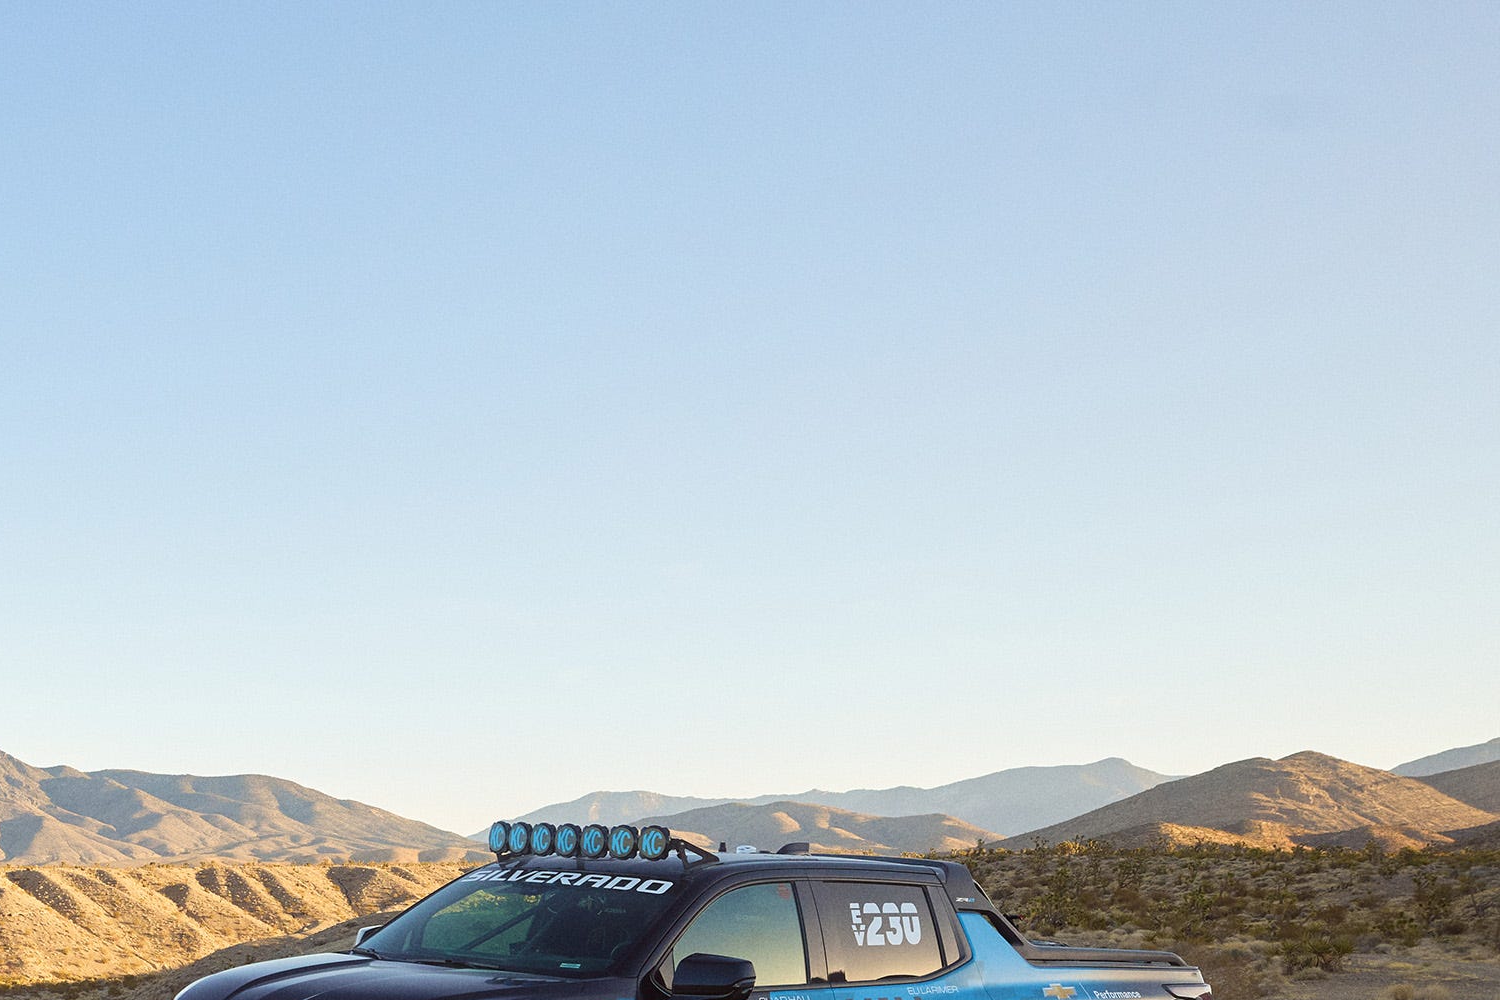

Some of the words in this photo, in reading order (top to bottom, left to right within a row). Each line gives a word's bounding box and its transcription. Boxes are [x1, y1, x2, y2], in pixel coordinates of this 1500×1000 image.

[490, 827, 504, 849] KC
[511, 826, 525, 850] KC
[533, 828, 548, 851] KC
[557, 828, 573, 852] KC
[583, 829, 601, 854] KC
[611, 830, 630, 855] KC
[642, 831, 662, 856] KC
[461, 869, 674, 895] SILVERADO
[863, 902, 921, 946] 230
[1093, 990, 1142, 1000] Performance
